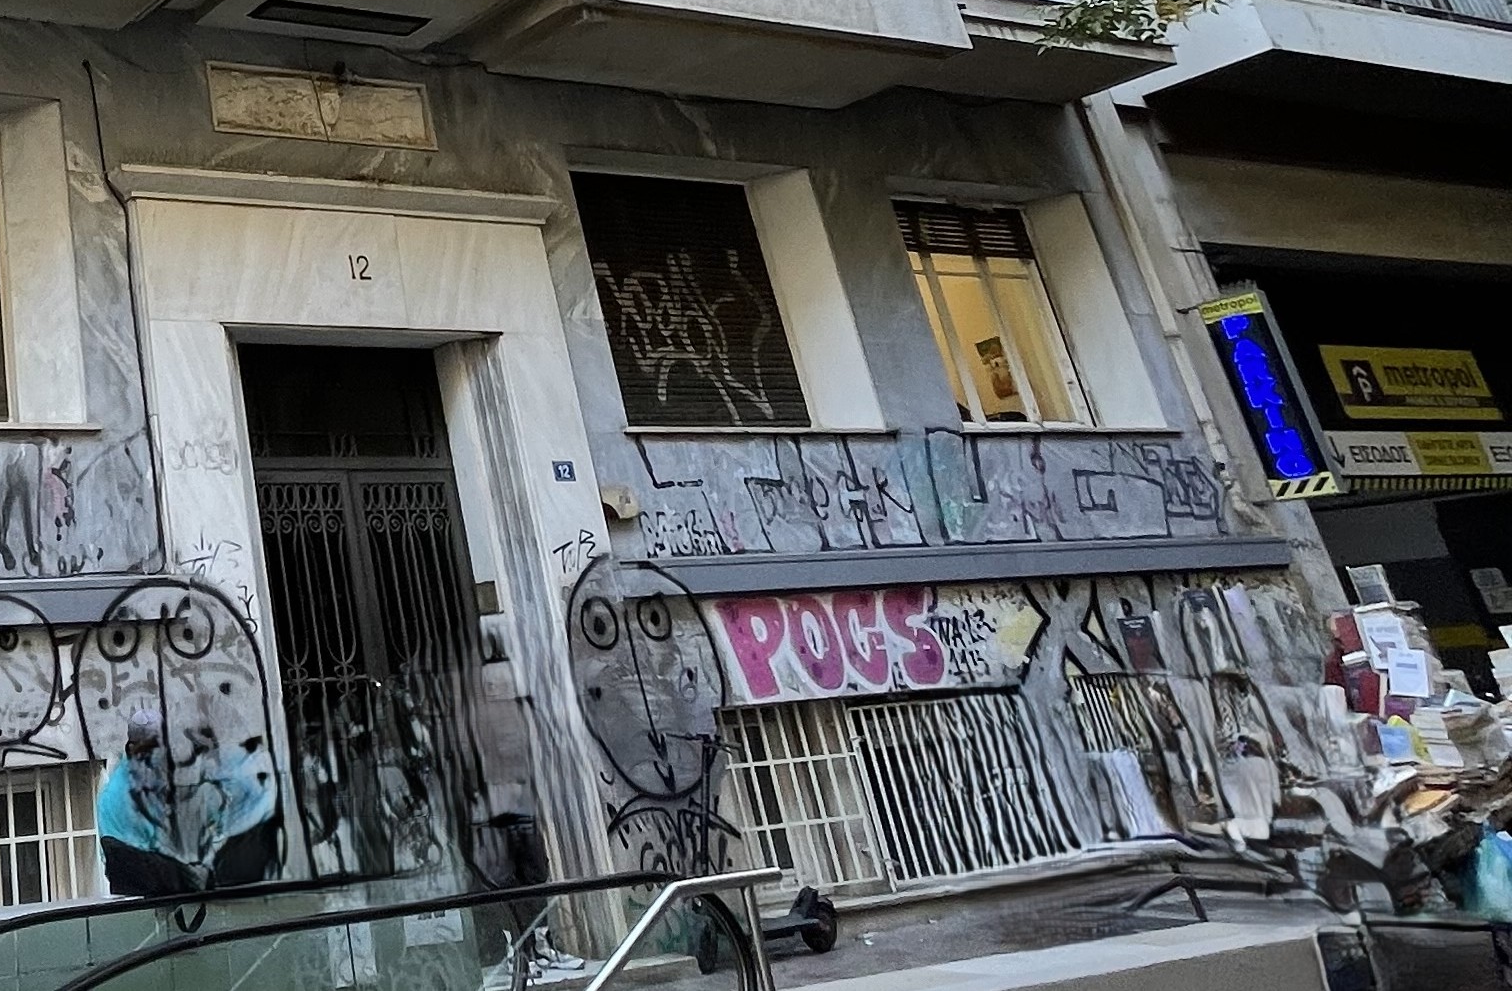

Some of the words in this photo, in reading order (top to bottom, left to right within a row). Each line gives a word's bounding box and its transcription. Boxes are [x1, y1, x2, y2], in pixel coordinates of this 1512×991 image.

[348, 254, 372, 280] 12
[1202, 294, 1257, 315] metropol
[1383, 362, 1478, 390] metropol
[557, 464, 571, 478] 12
